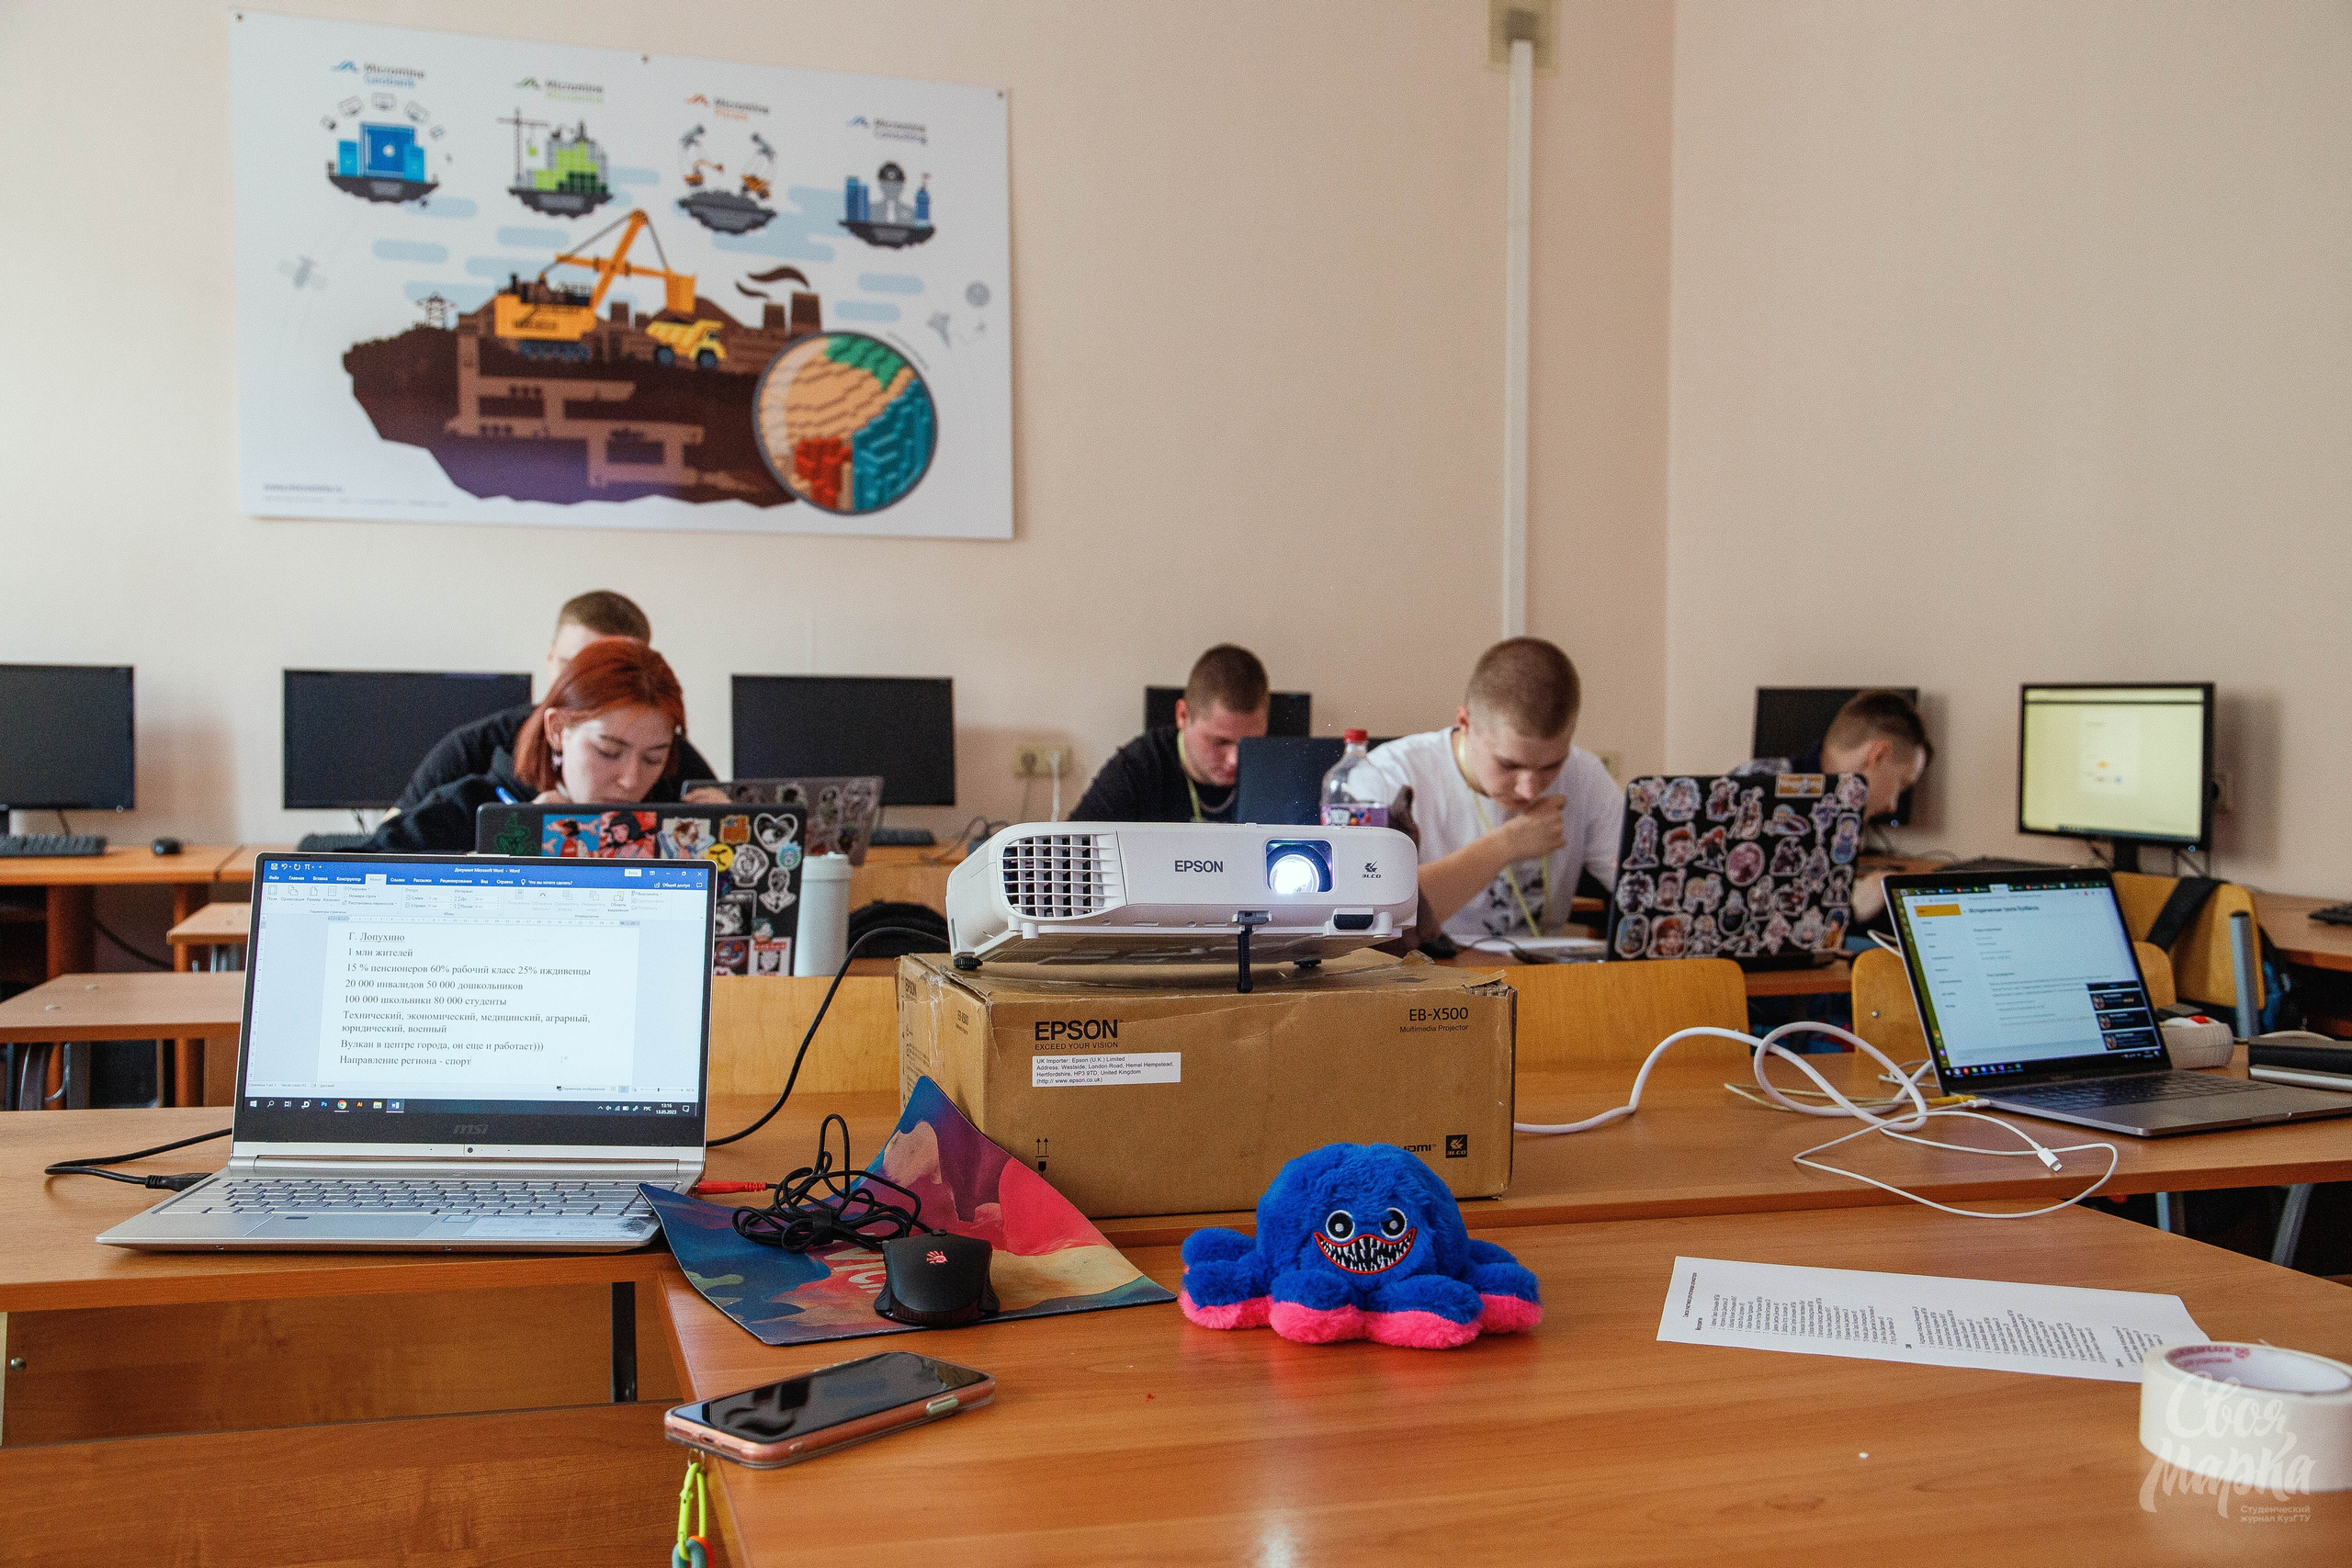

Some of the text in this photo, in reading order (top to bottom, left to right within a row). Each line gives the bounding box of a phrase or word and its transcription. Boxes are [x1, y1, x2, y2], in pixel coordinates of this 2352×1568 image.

[1174, 860, 1224, 873] EPSON
[349, 931, 404, 942] Г. Лопухино
[375, 948, 413, 957] жителей
[347, 963, 356, 972] 15
[359, 964, 368, 972] %
[370, 965, 428, 975] пенсионеров
[430, 964, 449, 973] 60%
[452, 964, 489, 975] рабочий
[518, 966, 537, 975] 25%
[345, 979, 356, 987] 20
[358, 979, 374, 988] 000
[426, 980, 436, 988] 50
[439, 981, 456, 989] 000
[345, 995, 360, 1003] 100
[447, 997, 462, 1005] 000
[465, 998, 507, 1007] студенты
[343, 1010, 590, 1023] Технический, экономический, медицинский, аграрный,
[1409, 1007, 1468, 1021] EB-X500
[342, 1024, 405, 1033] юридический,
[1035, 1020, 1118, 1041] EPSON
[341, 1040, 373, 1050] Вулкан
[494, 1042, 544, 1052] работает)))
[340, 1055, 399, 1066] Направление
[401, 1057, 436, 1066] региона
[446, 1058, 470, 1066] спорт
